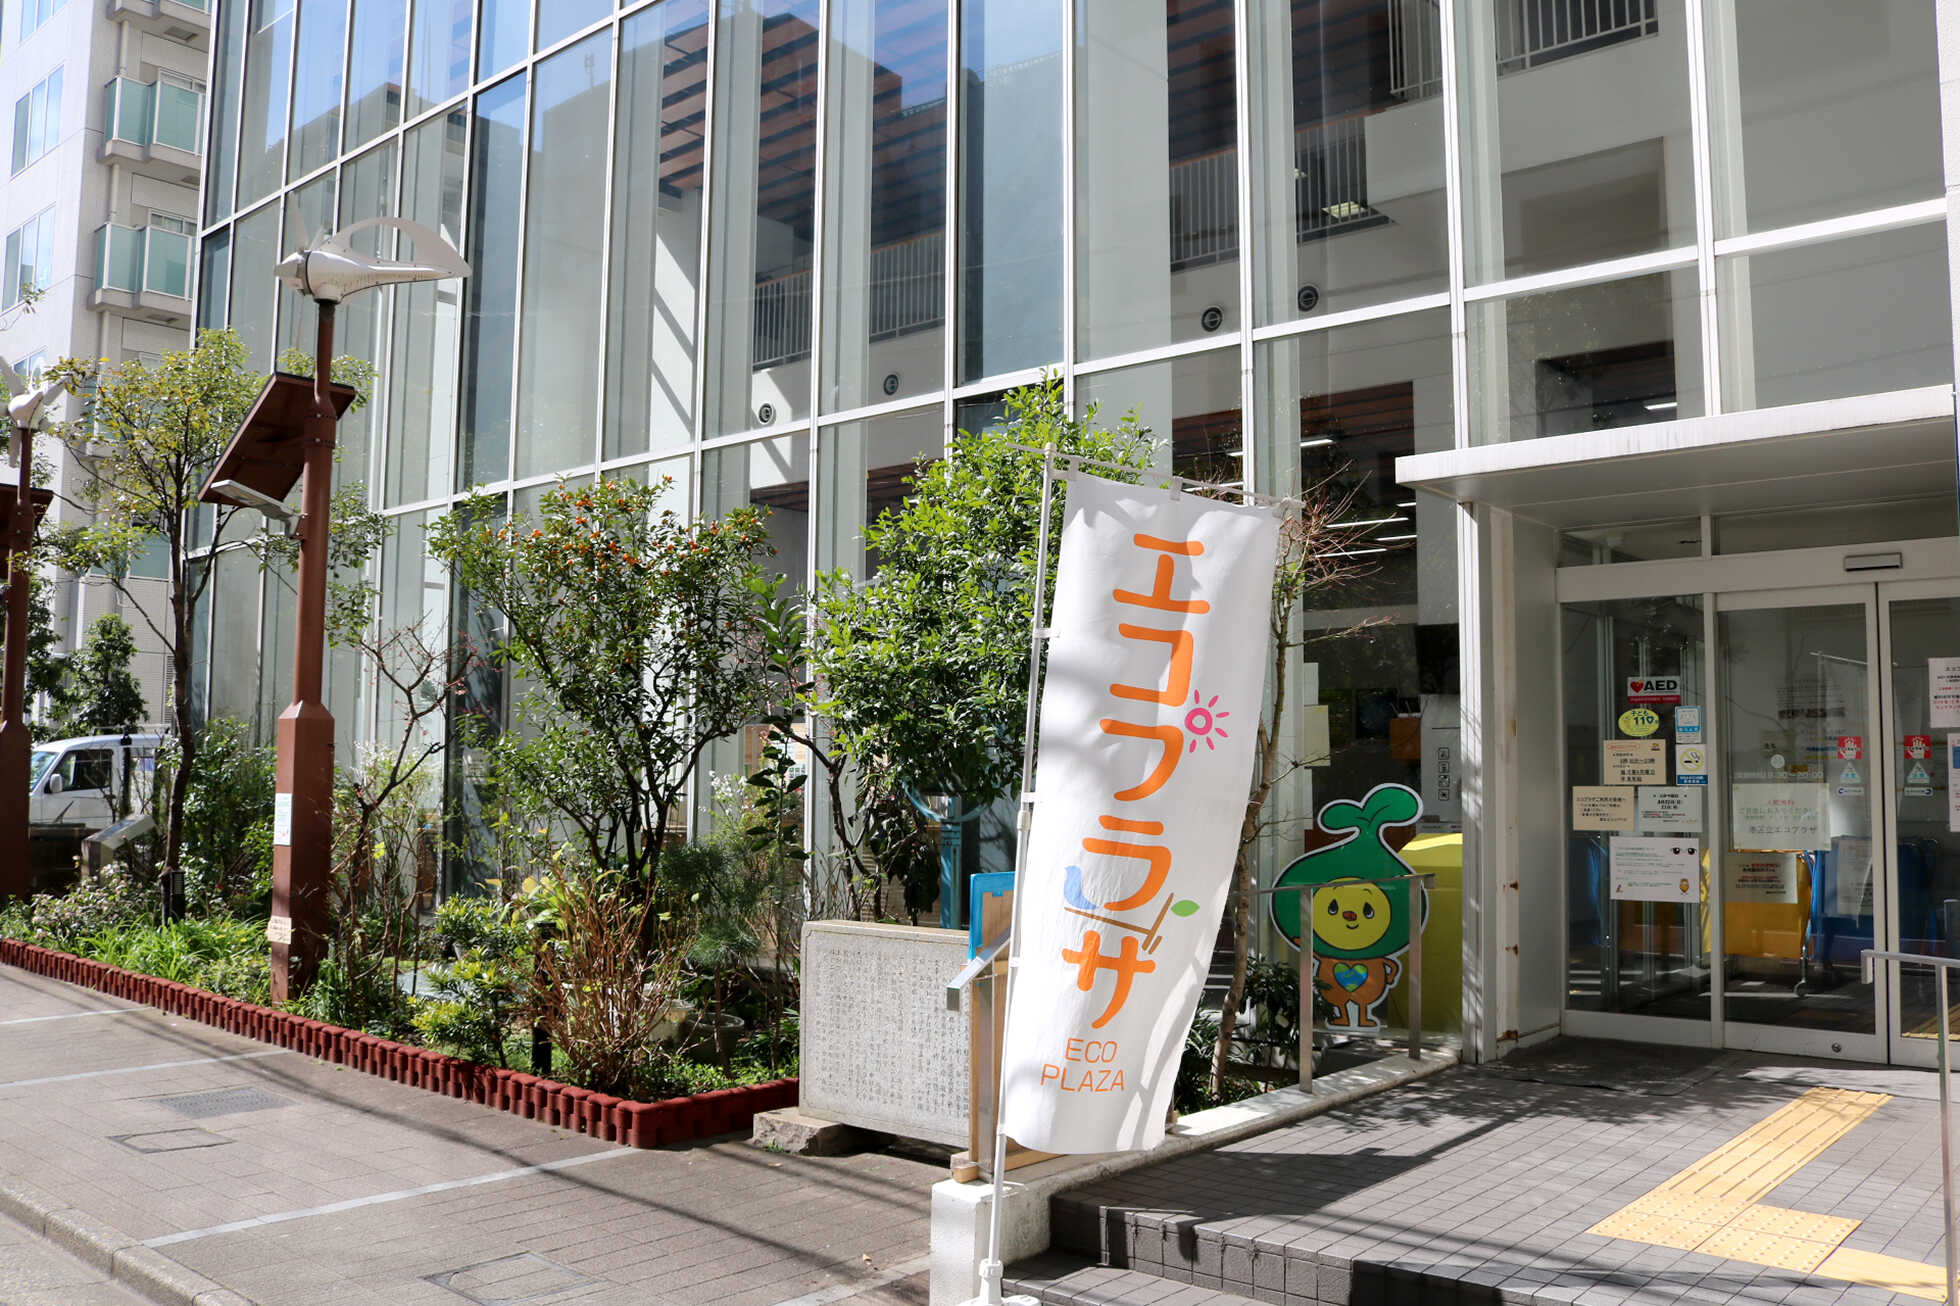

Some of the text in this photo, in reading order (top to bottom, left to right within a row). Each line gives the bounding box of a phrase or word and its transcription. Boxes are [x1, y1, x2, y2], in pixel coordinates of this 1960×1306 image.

[1644, 680, 1678, 691] AED
[1065, 1037, 1118, 1064] ECO
[1040, 1063, 1125, 1092] PLAZA
